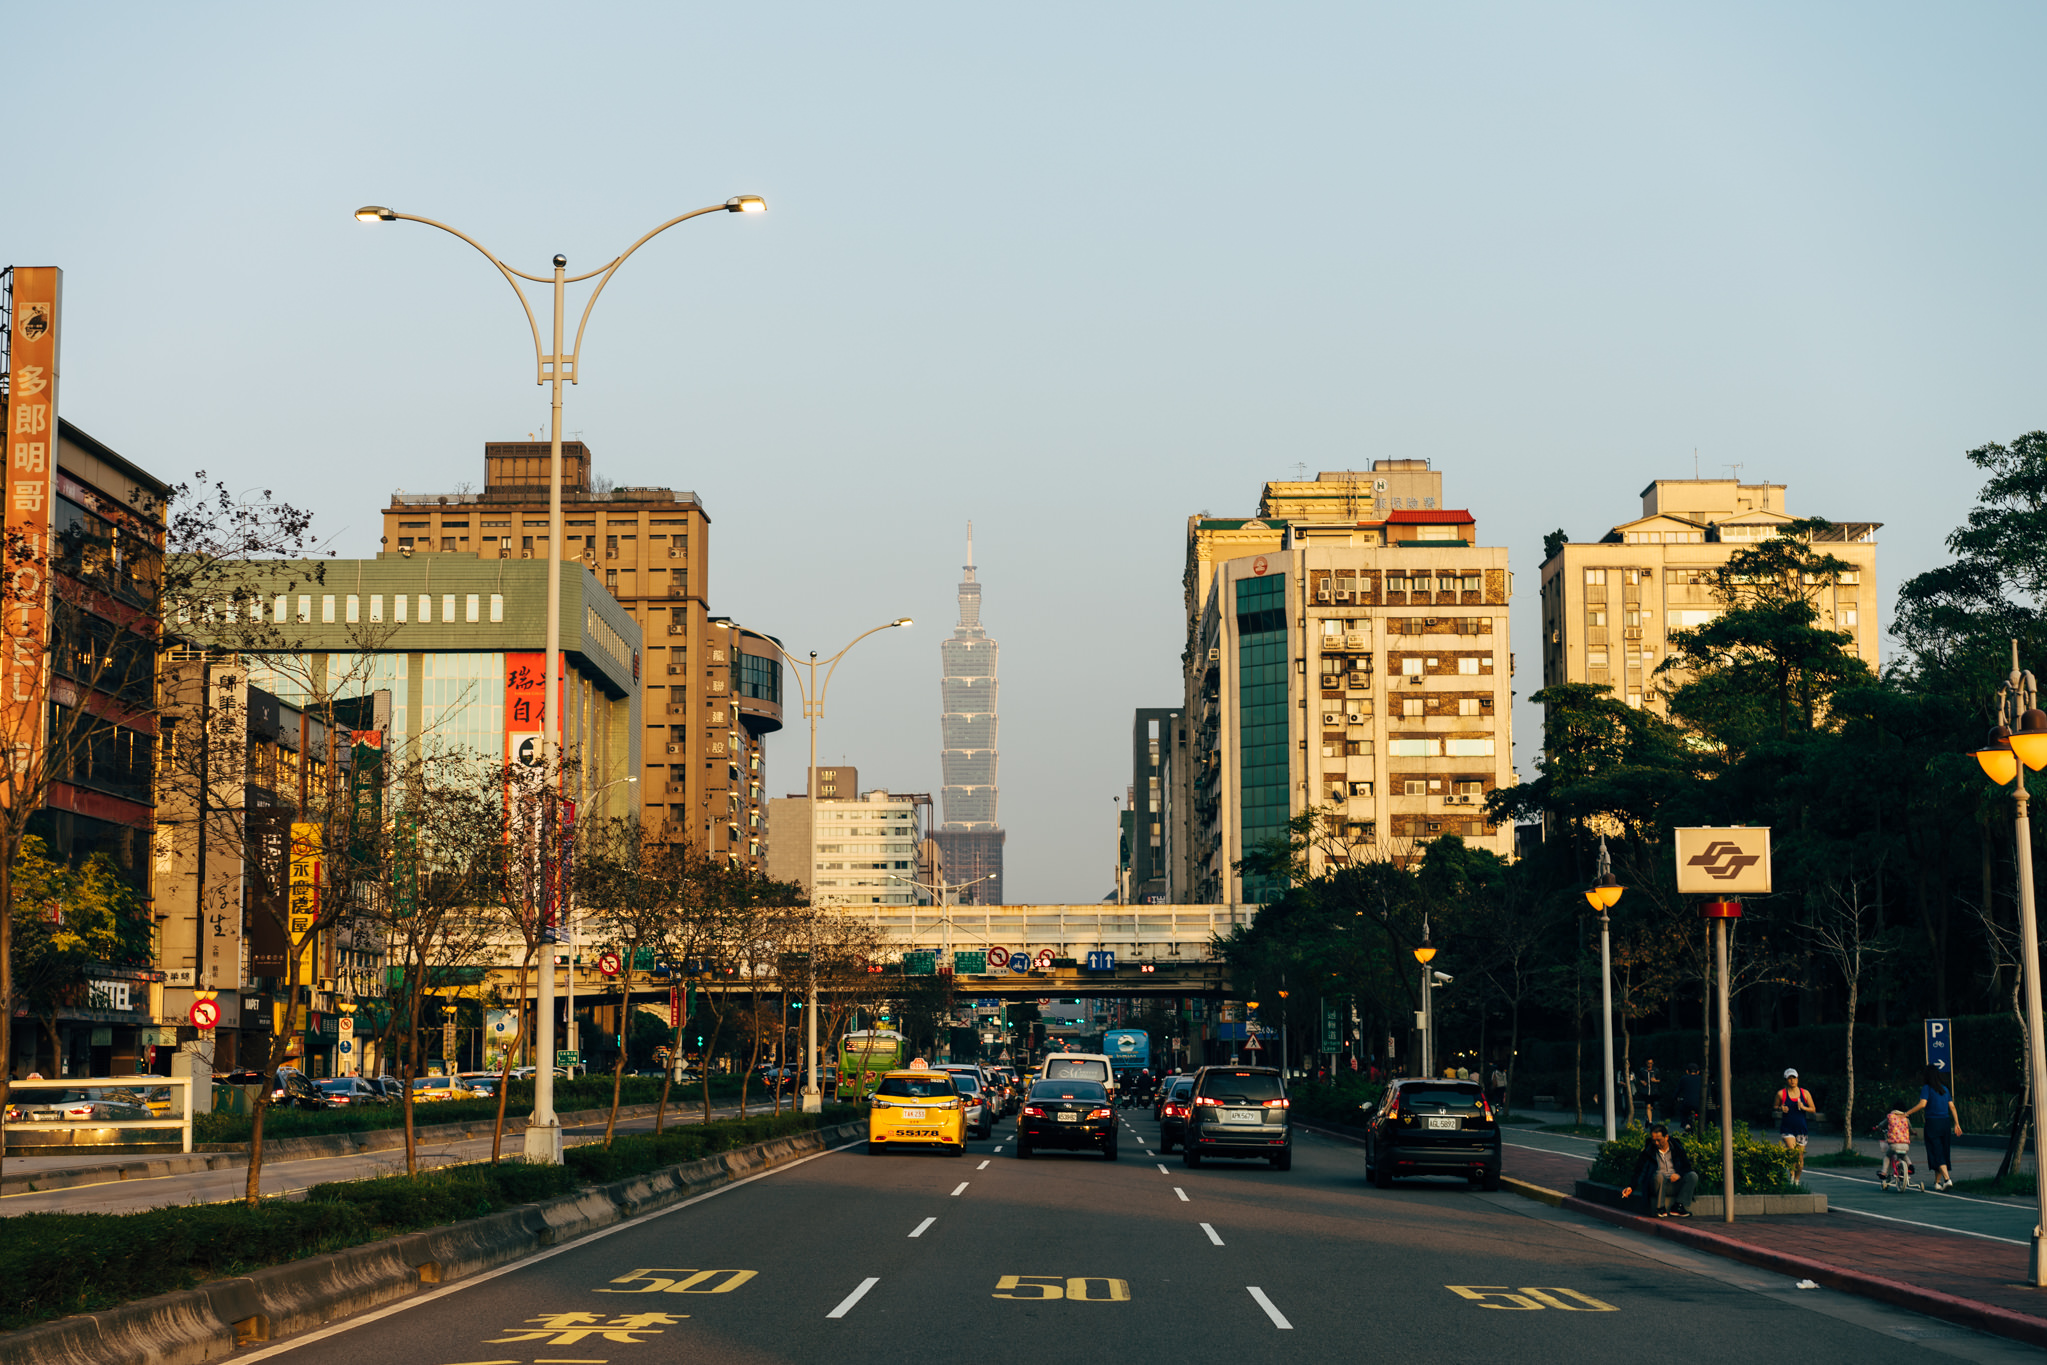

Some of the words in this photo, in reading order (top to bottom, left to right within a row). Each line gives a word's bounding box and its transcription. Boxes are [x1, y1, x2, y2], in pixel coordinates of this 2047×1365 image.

[13, 365, 47, 511] 多郎明哥
[13, 533, 40, 700] HOTEL
[712, 650, 724, 753] 龍聯建設
[291, 862, 309, 932] 永慶房屋
[1932, 1022, 1944, 1038] P
[592, 1269, 759, 1294] 50
[991, 1275, 1131, 1301] 50
[1444, 1285, 1621, 1312] 50
